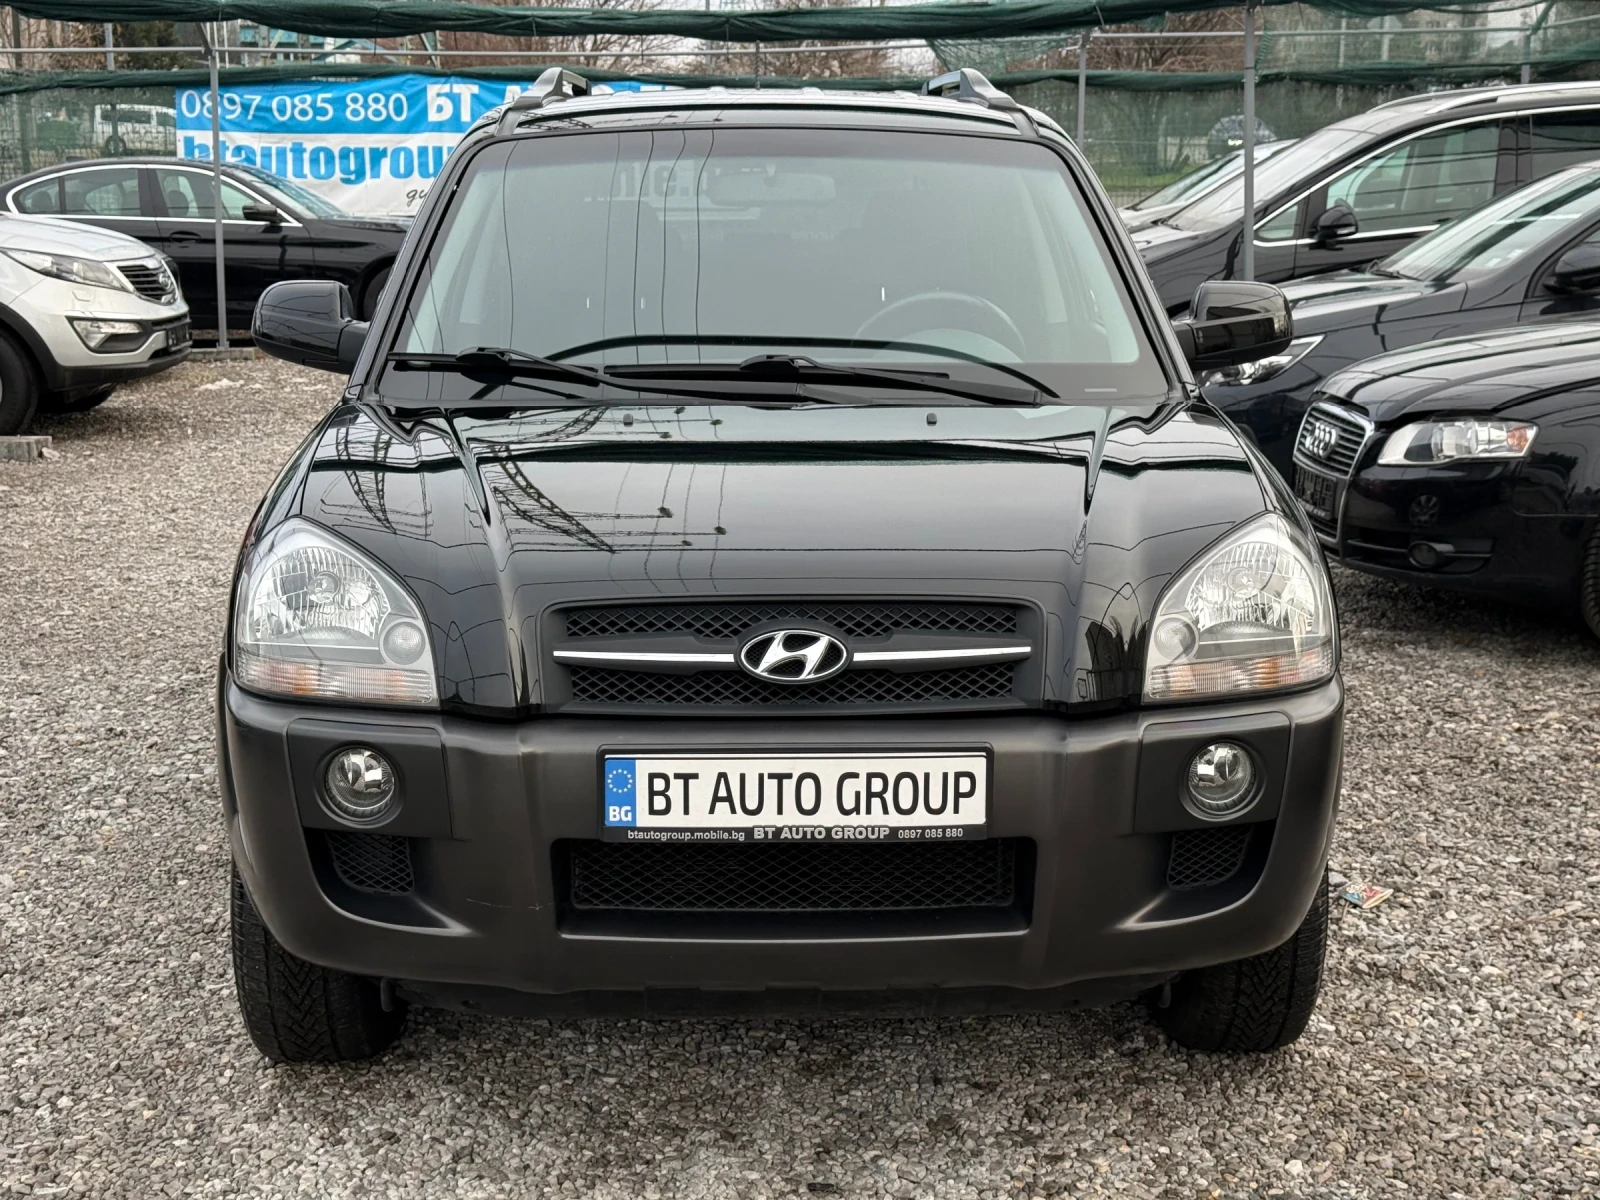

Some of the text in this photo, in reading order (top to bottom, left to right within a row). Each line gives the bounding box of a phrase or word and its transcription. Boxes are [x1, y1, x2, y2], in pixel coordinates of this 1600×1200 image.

[181, 90, 408, 122] 0897 085 880
[427, 84, 479, 122] БТ
[183, 136, 454, 185] bautogrou
[648, 771, 977, 816] BT AUTO GROUP
[609, 805, 632, 822] BG
[627, 830, 745, 842] btautogroup.mobile.bg
[753, 827, 890, 840] BT AUTO GROUP
[898, 828, 963, 839] 0897 085 880
